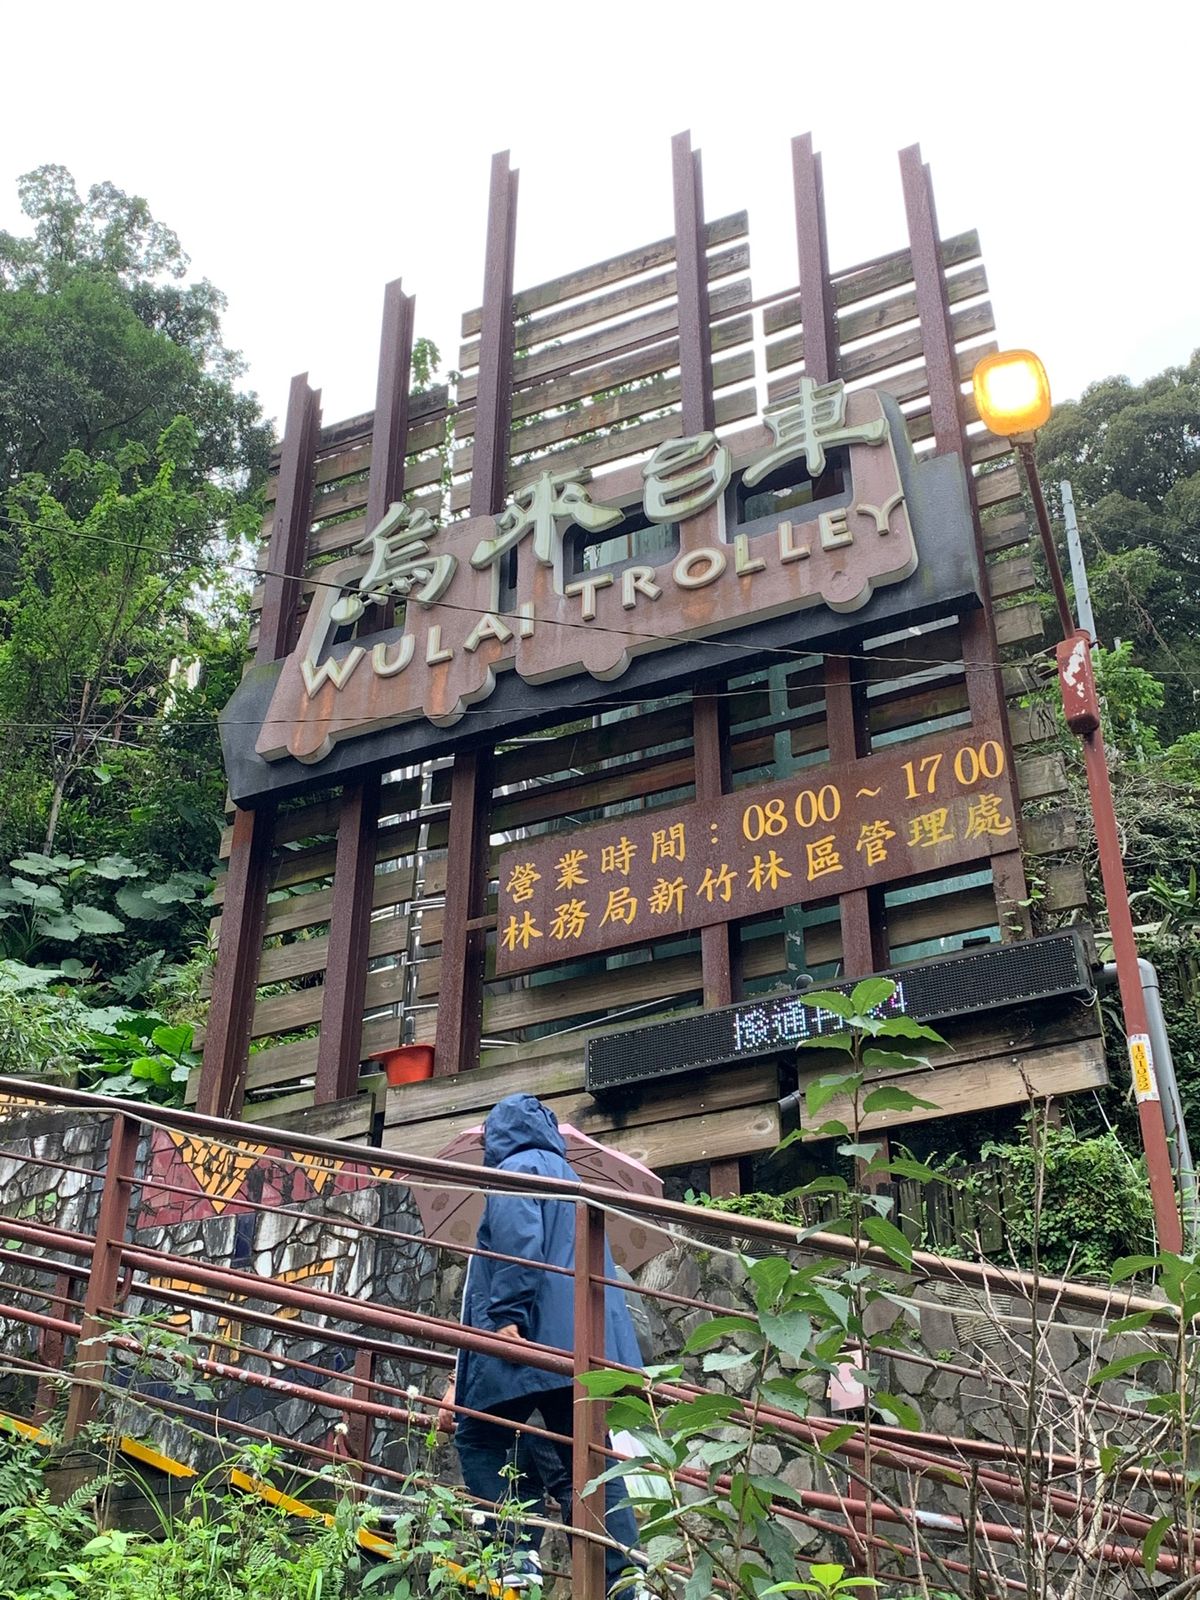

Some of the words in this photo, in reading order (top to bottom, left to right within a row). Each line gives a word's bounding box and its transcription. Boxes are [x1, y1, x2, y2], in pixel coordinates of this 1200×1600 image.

[300, 600, 536, 699] WULAI
[565, 494, 906, 620] TROLLEY
[501, 793, 1013, 951] 林務局新竹林區管理處
